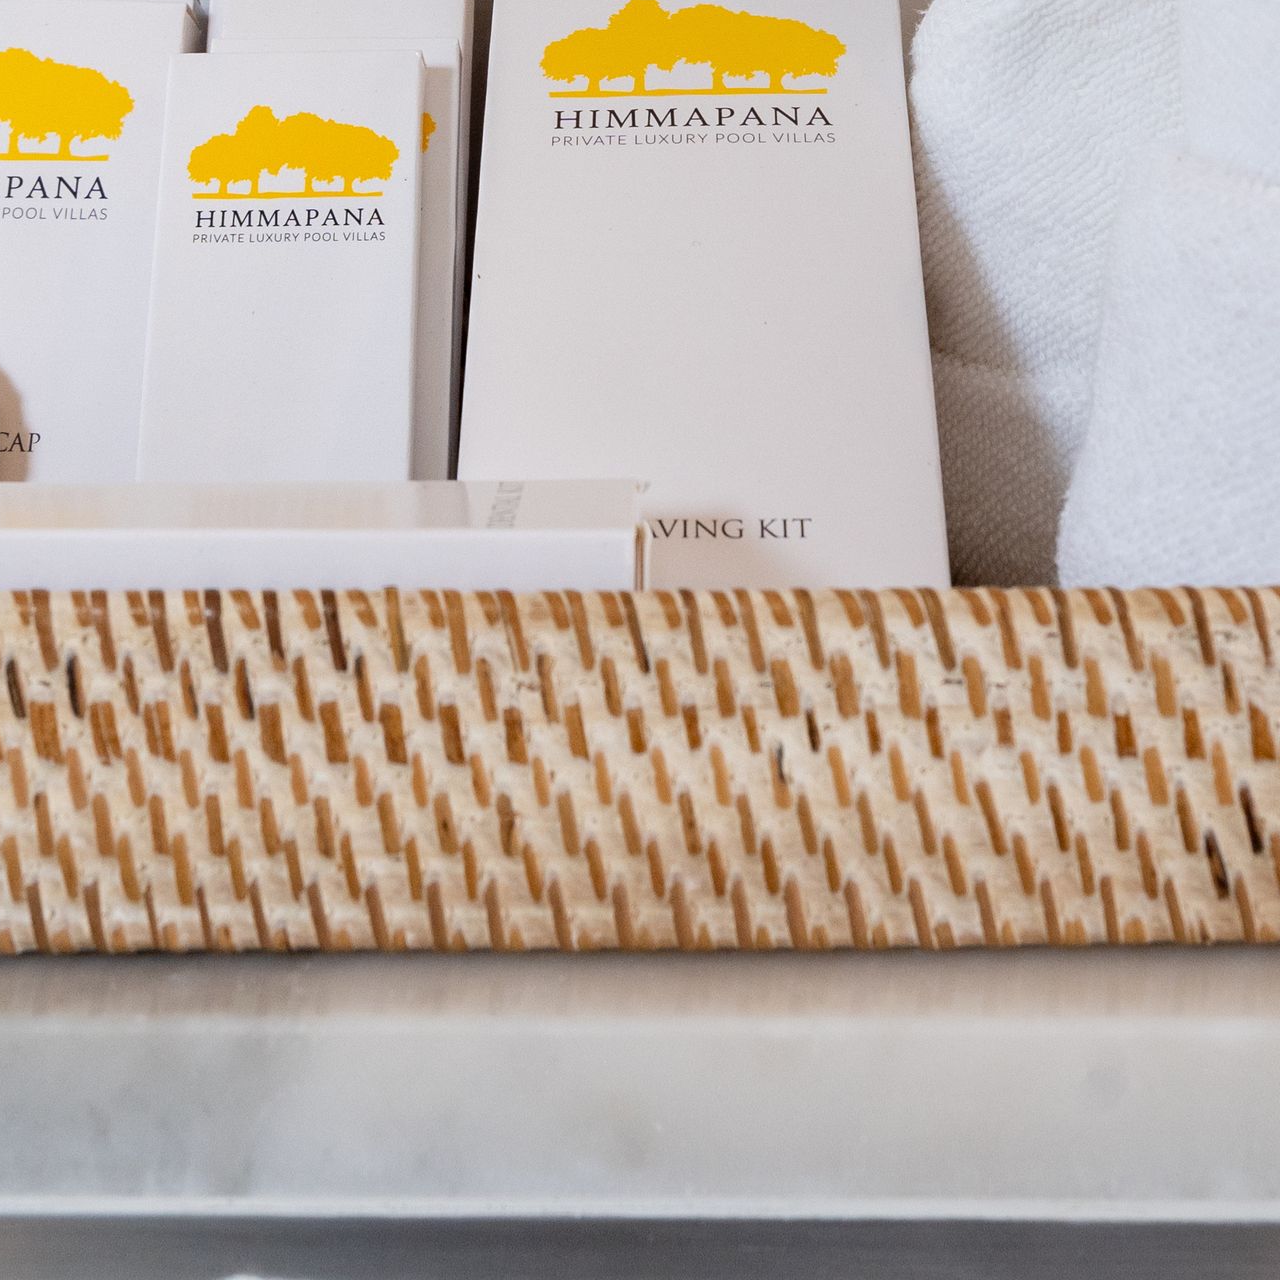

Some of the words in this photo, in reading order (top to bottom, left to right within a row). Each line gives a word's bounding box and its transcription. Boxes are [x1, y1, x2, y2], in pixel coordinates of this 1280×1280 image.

[553, 106, 834, 130] HIMMAPANA
[551, 134, 628, 147] PRIVATE
[634, 132, 709, 146] LUXURY
[715, 132, 767, 144] POOL
[771, 132, 836, 144] VILLAS
[1, 207, 48, 220] POOL
[52, 207, 108, 221] VILLAS
[194, 207, 386, 229] HIMMAPANA
[192, 233, 246, 244] PRIVATE
[248, 232, 301, 244] LUXURY
[303, 232, 340, 243] POOL
[342, 231, 386, 242] VILLAS
[758, 518, 813, 540] KIT
